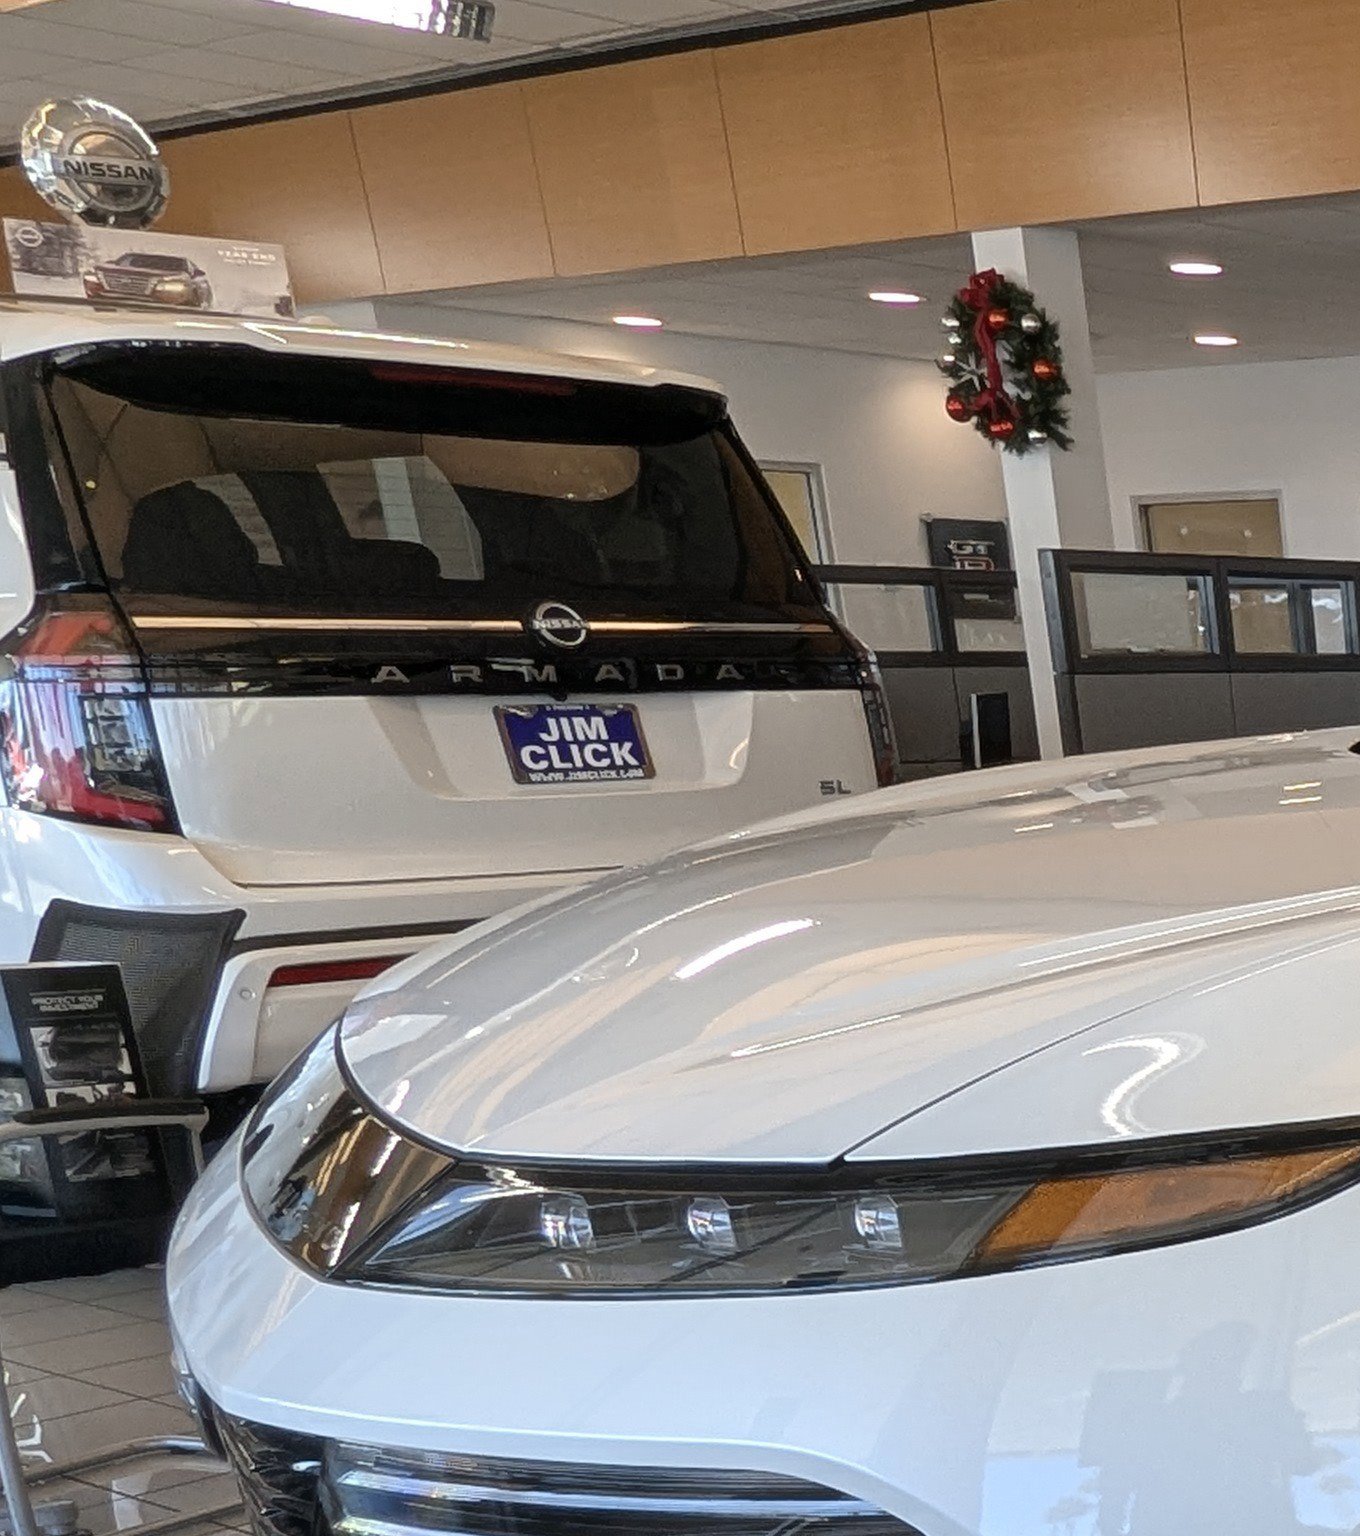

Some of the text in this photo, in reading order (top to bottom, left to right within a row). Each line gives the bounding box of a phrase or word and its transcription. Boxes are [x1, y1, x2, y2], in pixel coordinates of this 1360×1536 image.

[64, 159, 155, 182] NISSAN
[532, 619, 591, 631] NISSAN
[371, 663, 745, 684] ARMADA
[538, 716, 609, 742] JIM
[520, 741, 640, 770] CLICK
[819, 779, 852, 795] SL
